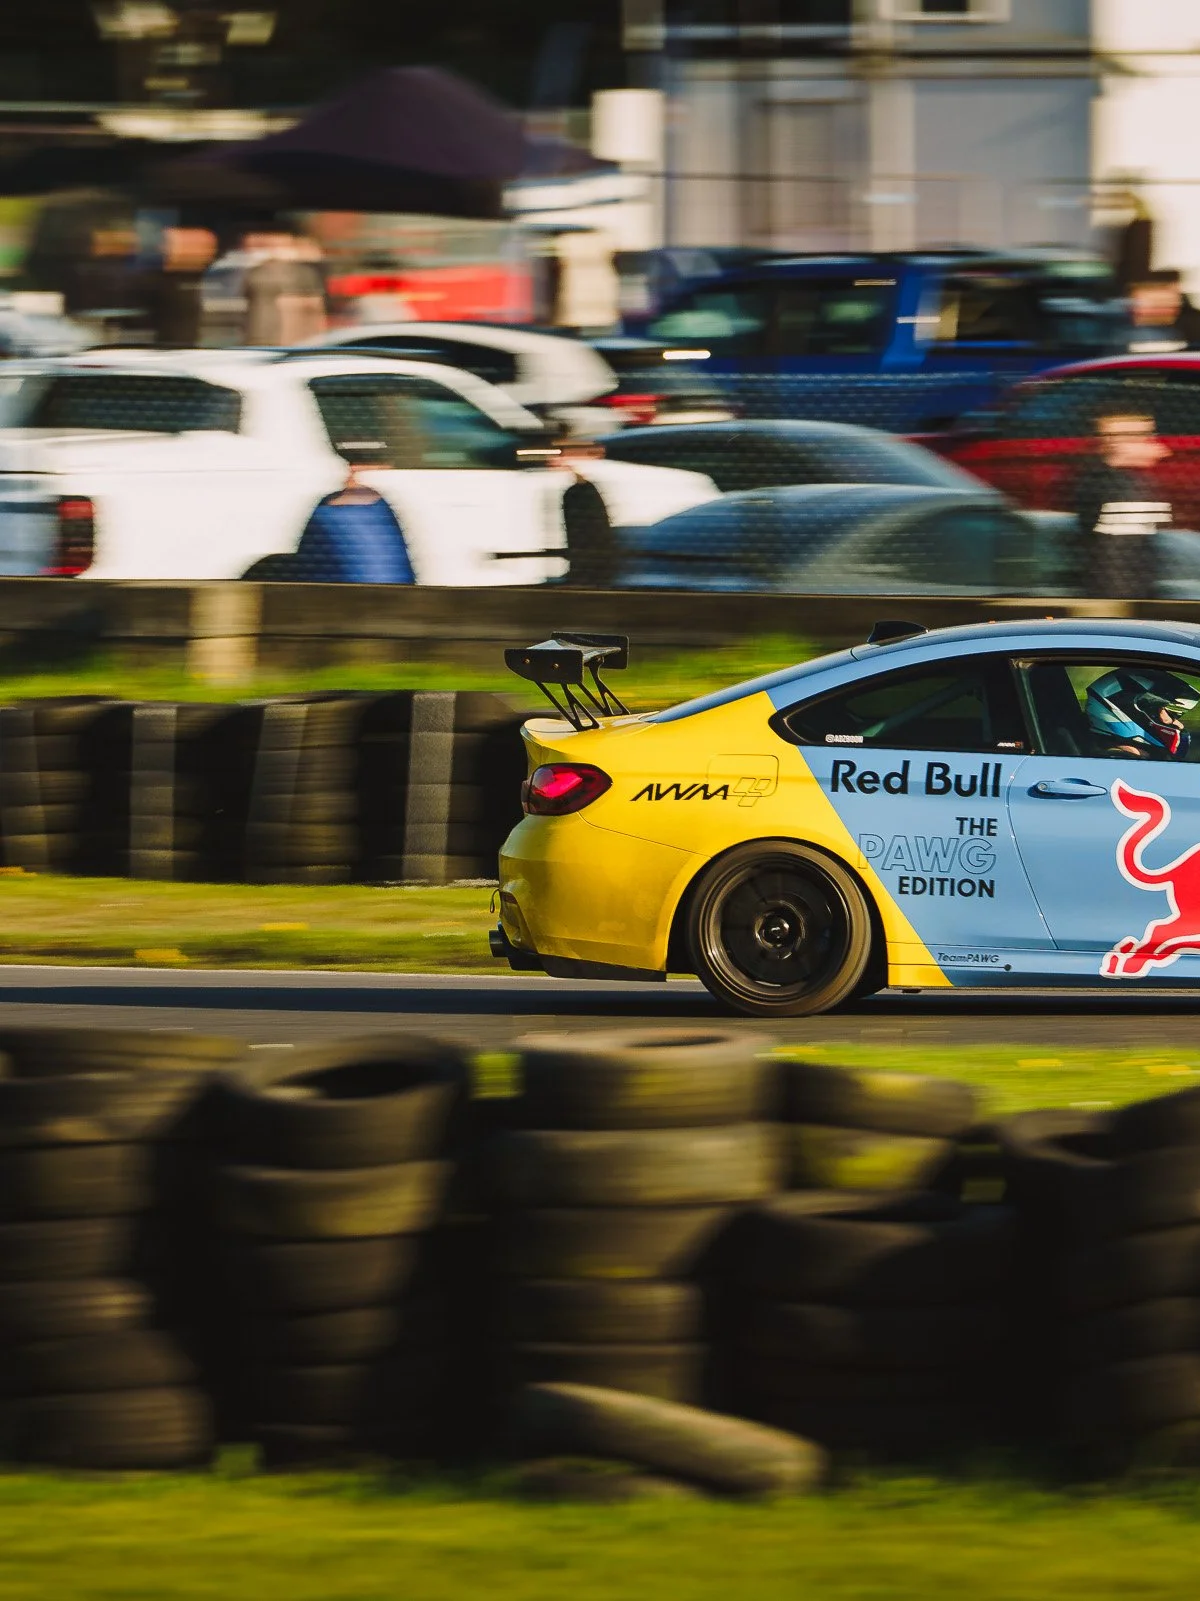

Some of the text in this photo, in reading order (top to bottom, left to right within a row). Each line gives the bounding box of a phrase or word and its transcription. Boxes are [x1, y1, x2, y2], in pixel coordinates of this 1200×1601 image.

[831, 760, 1003, 798] Red Bull
[955, 816, 998, 837] THE
[857, 833, 997, 875] PAWG
[898, 876, 995, 899] EDITION
